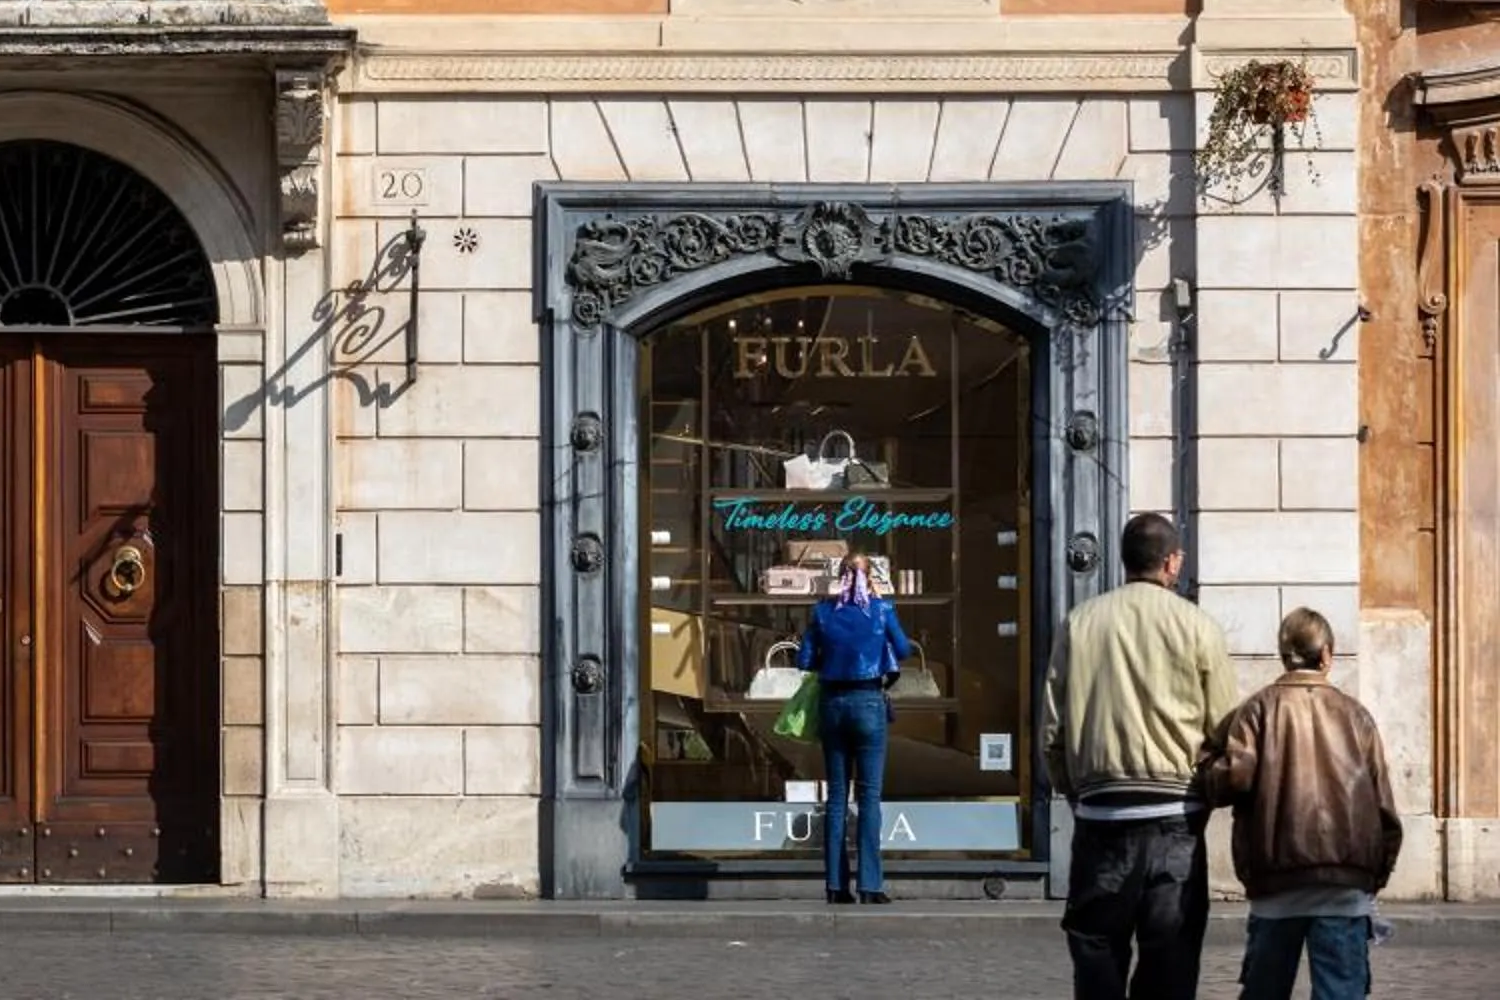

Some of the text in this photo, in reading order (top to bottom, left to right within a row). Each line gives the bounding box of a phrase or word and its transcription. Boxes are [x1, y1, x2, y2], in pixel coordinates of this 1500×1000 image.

[381, 171, 423, 198] 20
[733, 335, 937, 379] FURLA
[713, 495, 956, 536] Timeless Elegance
[753, 810, 917, 842] FUA
